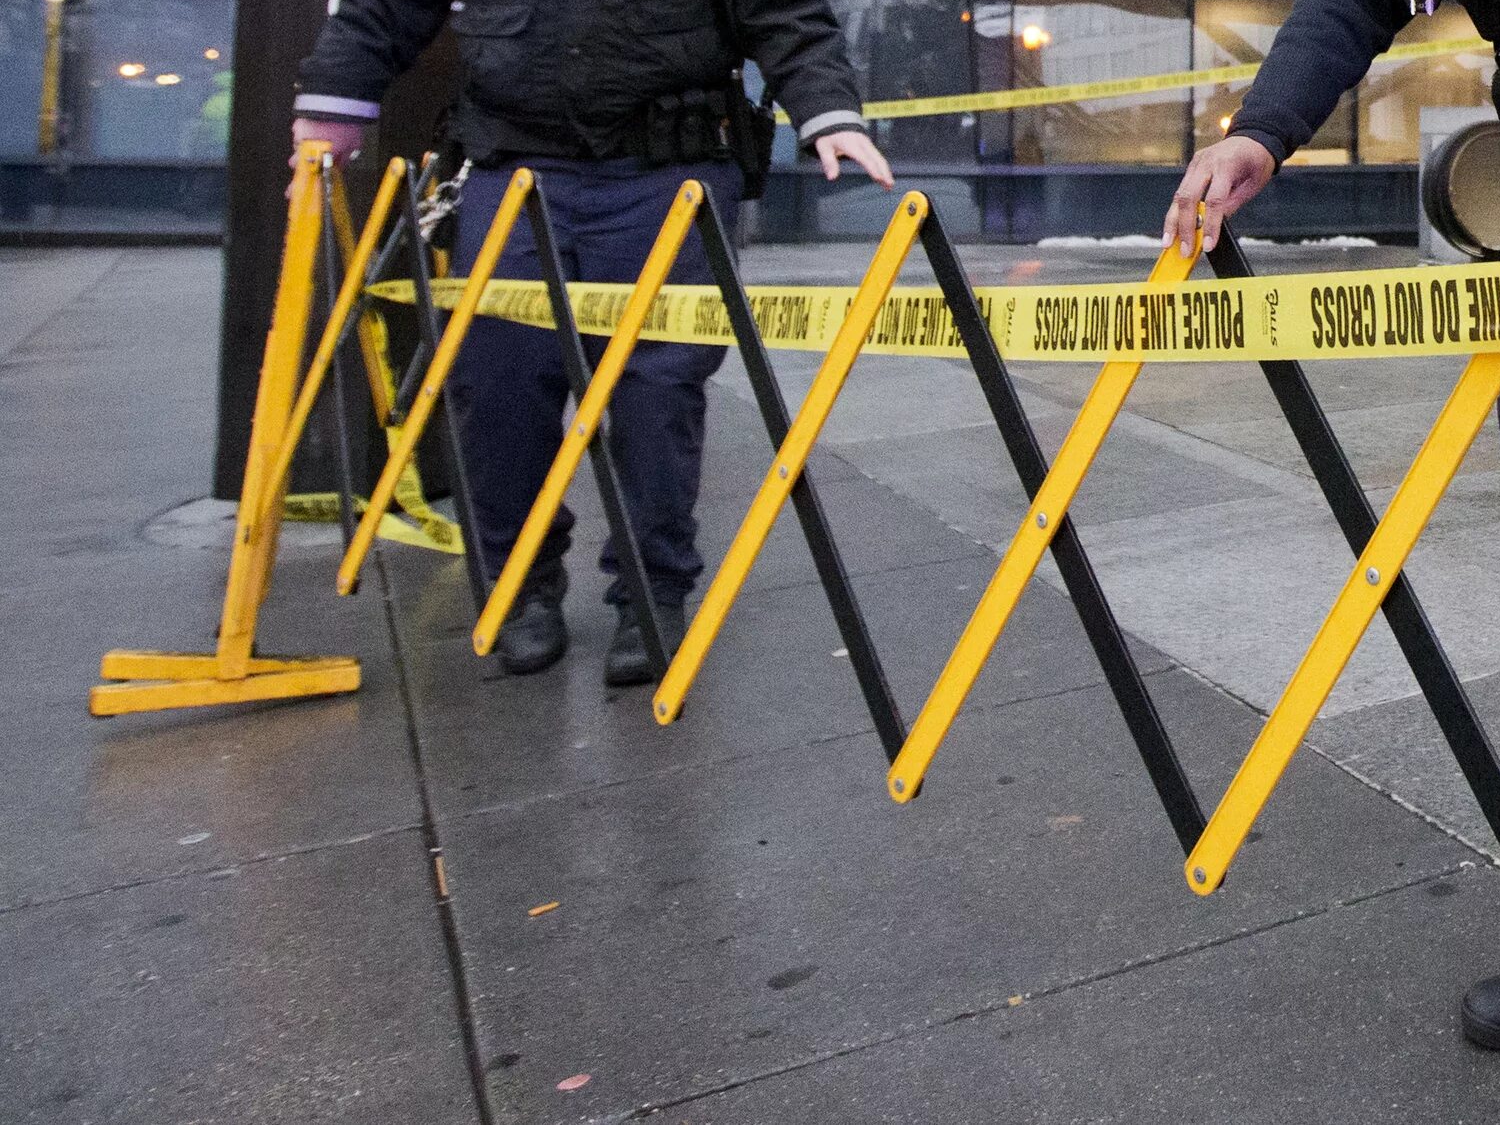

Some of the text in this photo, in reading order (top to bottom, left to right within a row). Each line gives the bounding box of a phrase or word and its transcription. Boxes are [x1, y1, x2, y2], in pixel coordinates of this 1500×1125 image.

[877, 297, 901, 346] NOT
[901, 297, 920, 346] DO
[1034, 296, 1078, 351] CROSS
[1081, 296, 1110, 351] NOT
[1114, 295, 1134, 351] DO
[1139, 292, 1177, 351] LINE
[1182, 289, 1244, 350] POLICE
[1310, 284, 1377, 349] CROSS
[1384, 282, 1425, 346] NOT
[1430, 279, 1460, 343] DO
